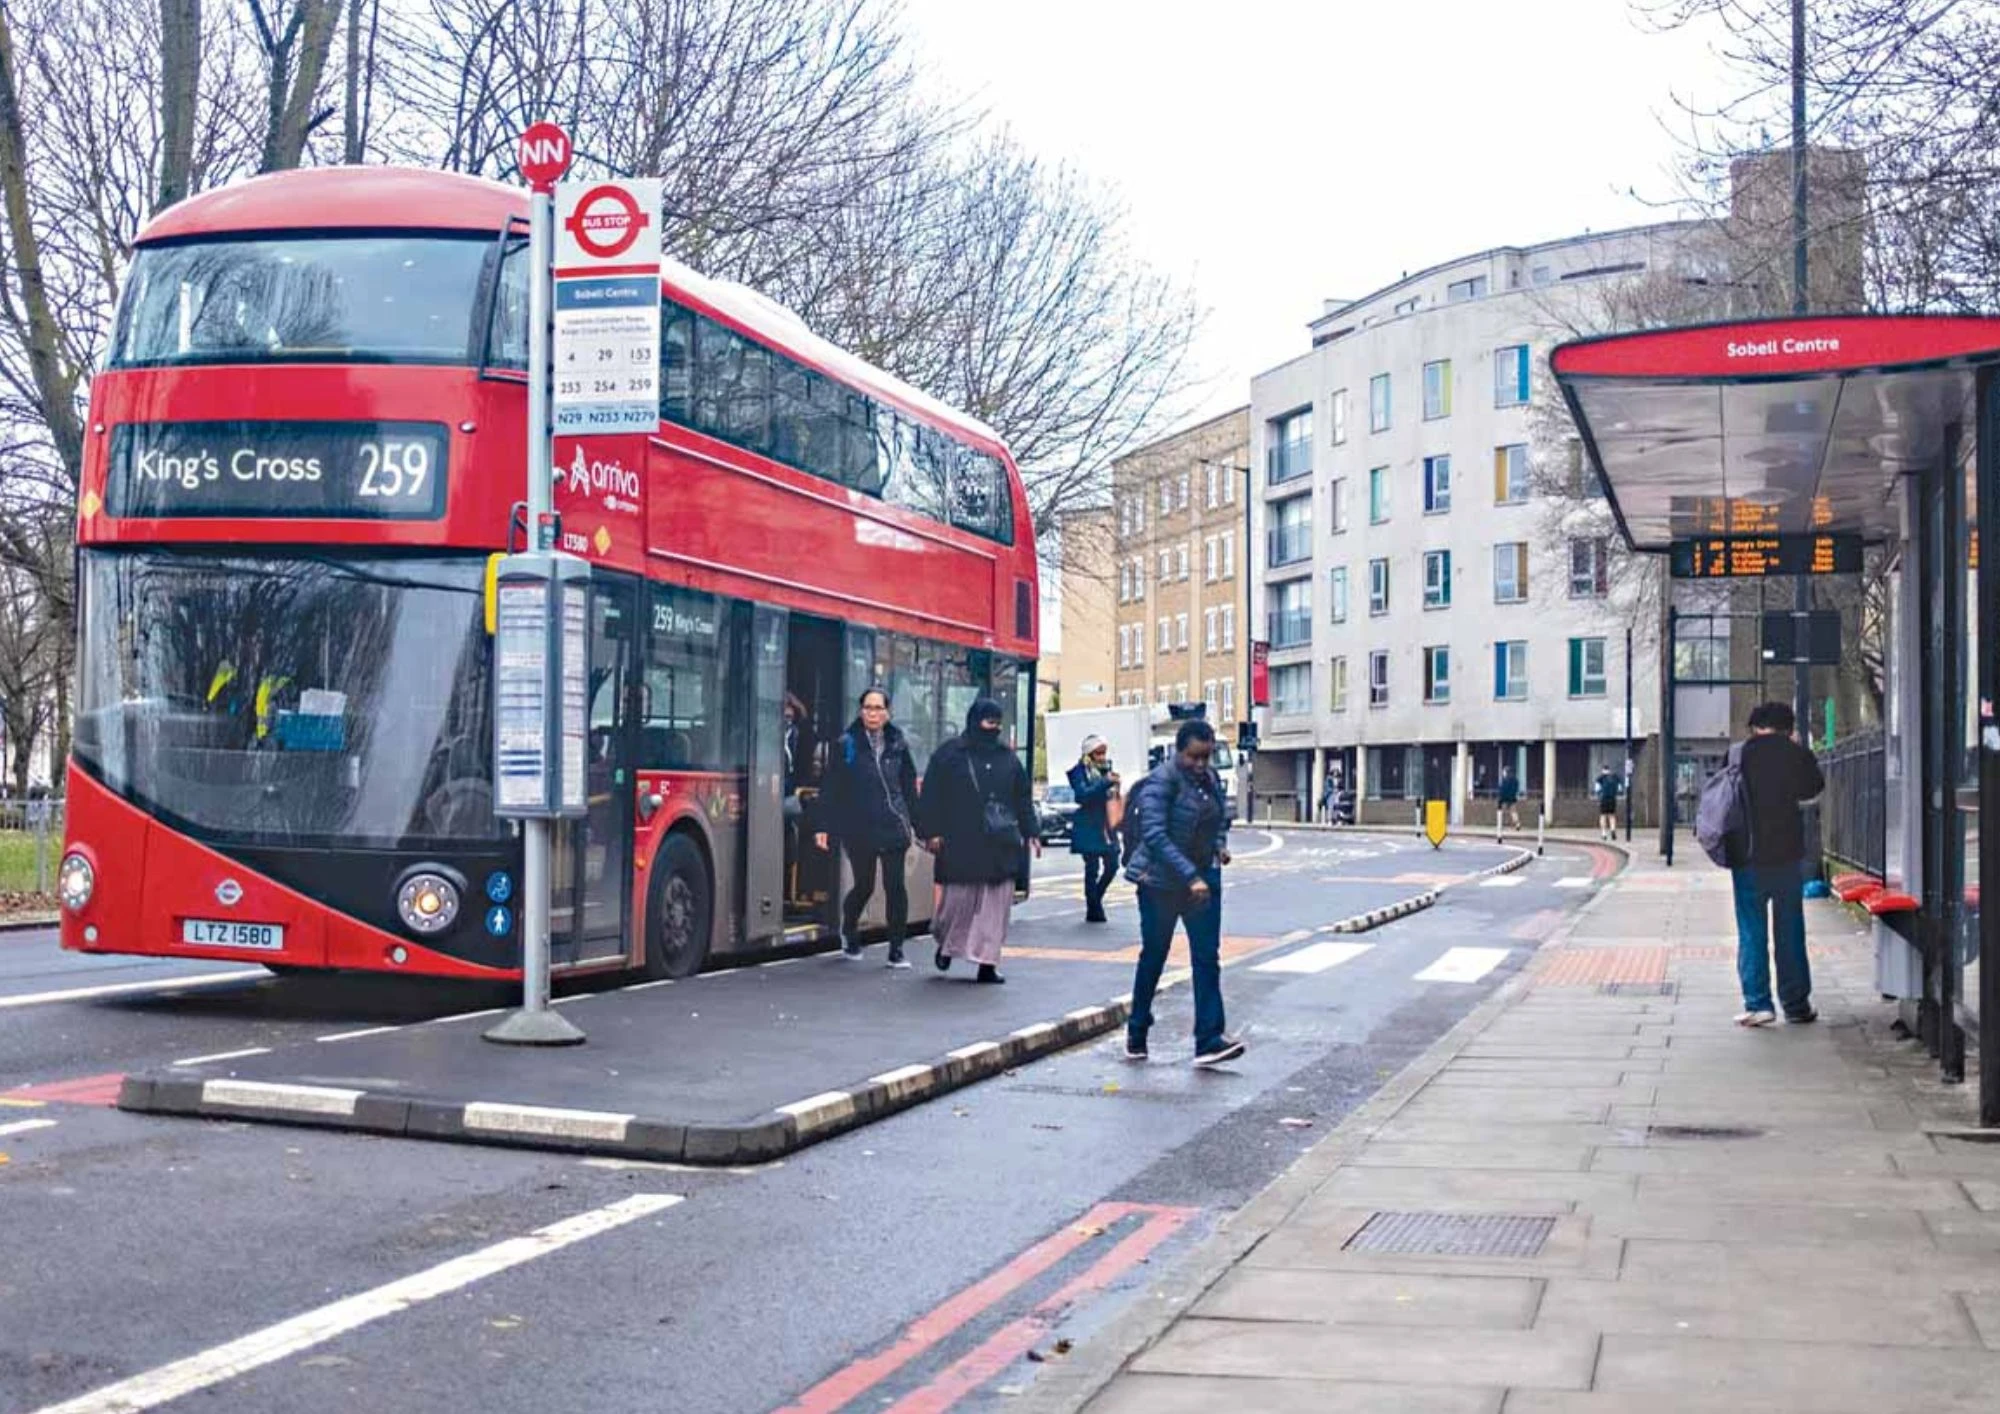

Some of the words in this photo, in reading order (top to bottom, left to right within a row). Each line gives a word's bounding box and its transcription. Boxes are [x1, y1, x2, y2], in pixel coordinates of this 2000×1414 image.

[521, 138, 565, 167] NN
[581, 216, 602, 228] BUS
[603, 215, 631, 227] STOP
[574, 288, 604, 300] Sobell
[605, 287, 639, 298] Centre
[598, 349, 614, 361] 29
[630, 348, 652, 361] 153
[1726, 340, 1778, 358] Sobell
[1782, 338, 1840, 354] Centre
[594, 380, 616, 393] 254
[628, 379, 653, 391] 259
[558, 412, 583, 424] N29
[588, 412, 620, 423] N253
[624, 411, 656, 422] N279
[137, 449, 220, 489] King's
[231, 449, 322, 480] Cross
[358, 443, 428, 497] 259
[591, 460, 640, 498] arriva
[653, 604, 674, 631] 259
[193, 923, 228, 942] LTZ
[232, 926, 272, 945] 1580
